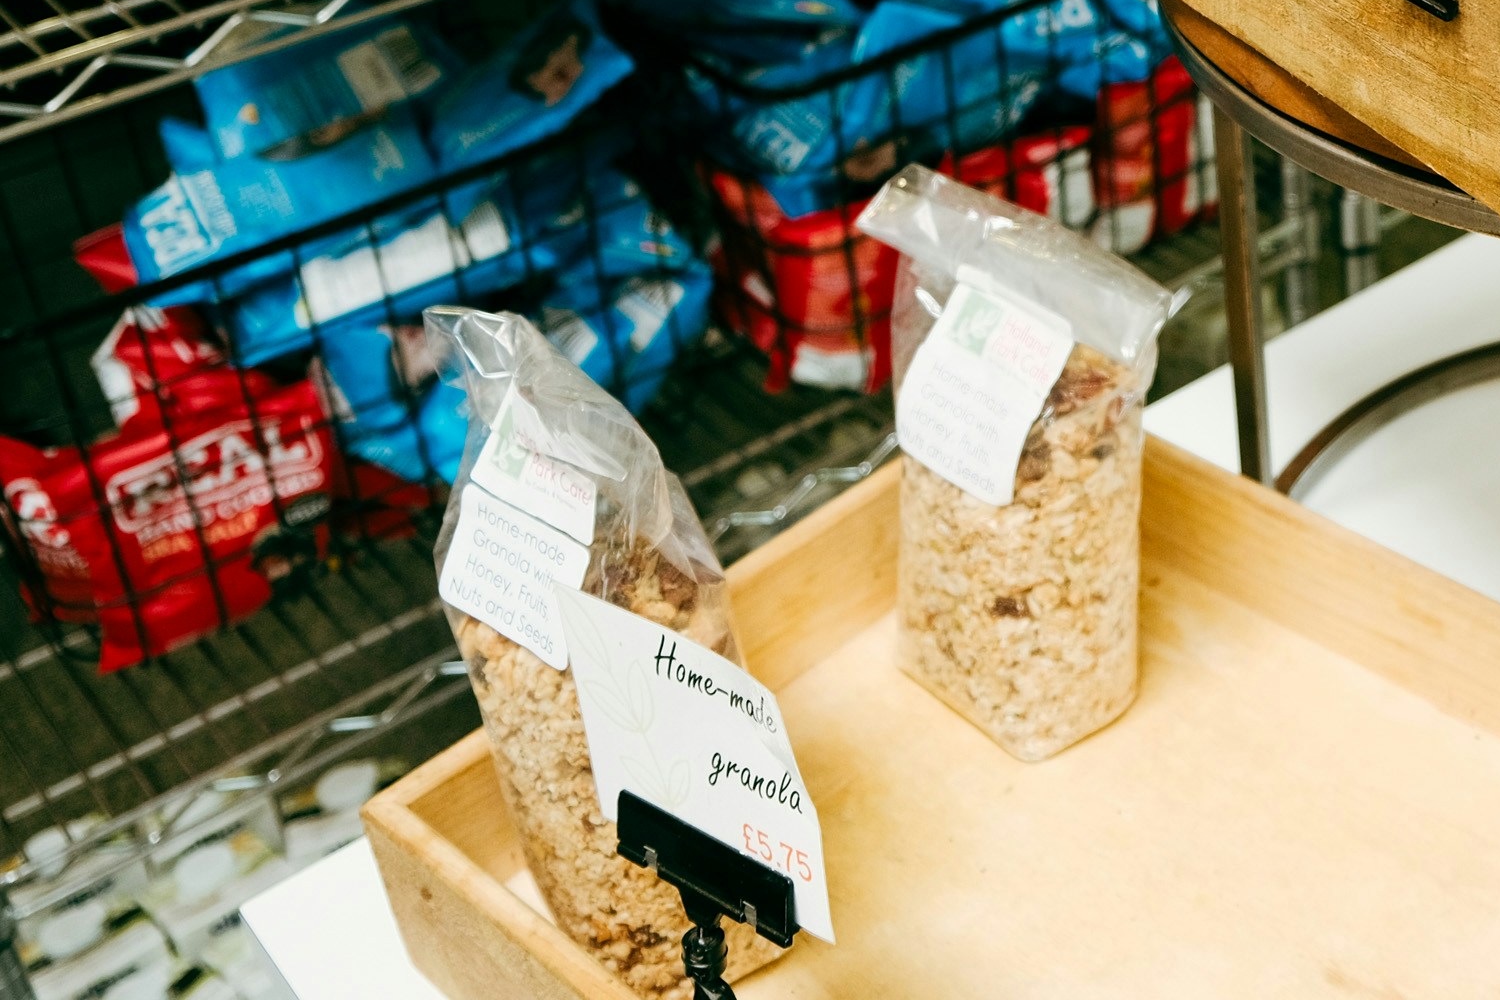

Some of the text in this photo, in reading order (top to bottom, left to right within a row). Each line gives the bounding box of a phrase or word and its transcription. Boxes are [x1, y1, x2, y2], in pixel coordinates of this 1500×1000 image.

[919, 383, 1000, 445] Granola with
[931, 360, 1008, 420] Home-made
[528, 452, 558, 488] Park
[472, 528, 530, 575] Granola
[476, 501, 566, 567] Home-made
[464, 552, 514, 598] Honey,
[449, 576, 554, 656] Nuts and Seeds
[654, 632, 778, 735] Home-made
[708, 751, 803, 815] granola
[742, 823, 813, 882] £5.75
